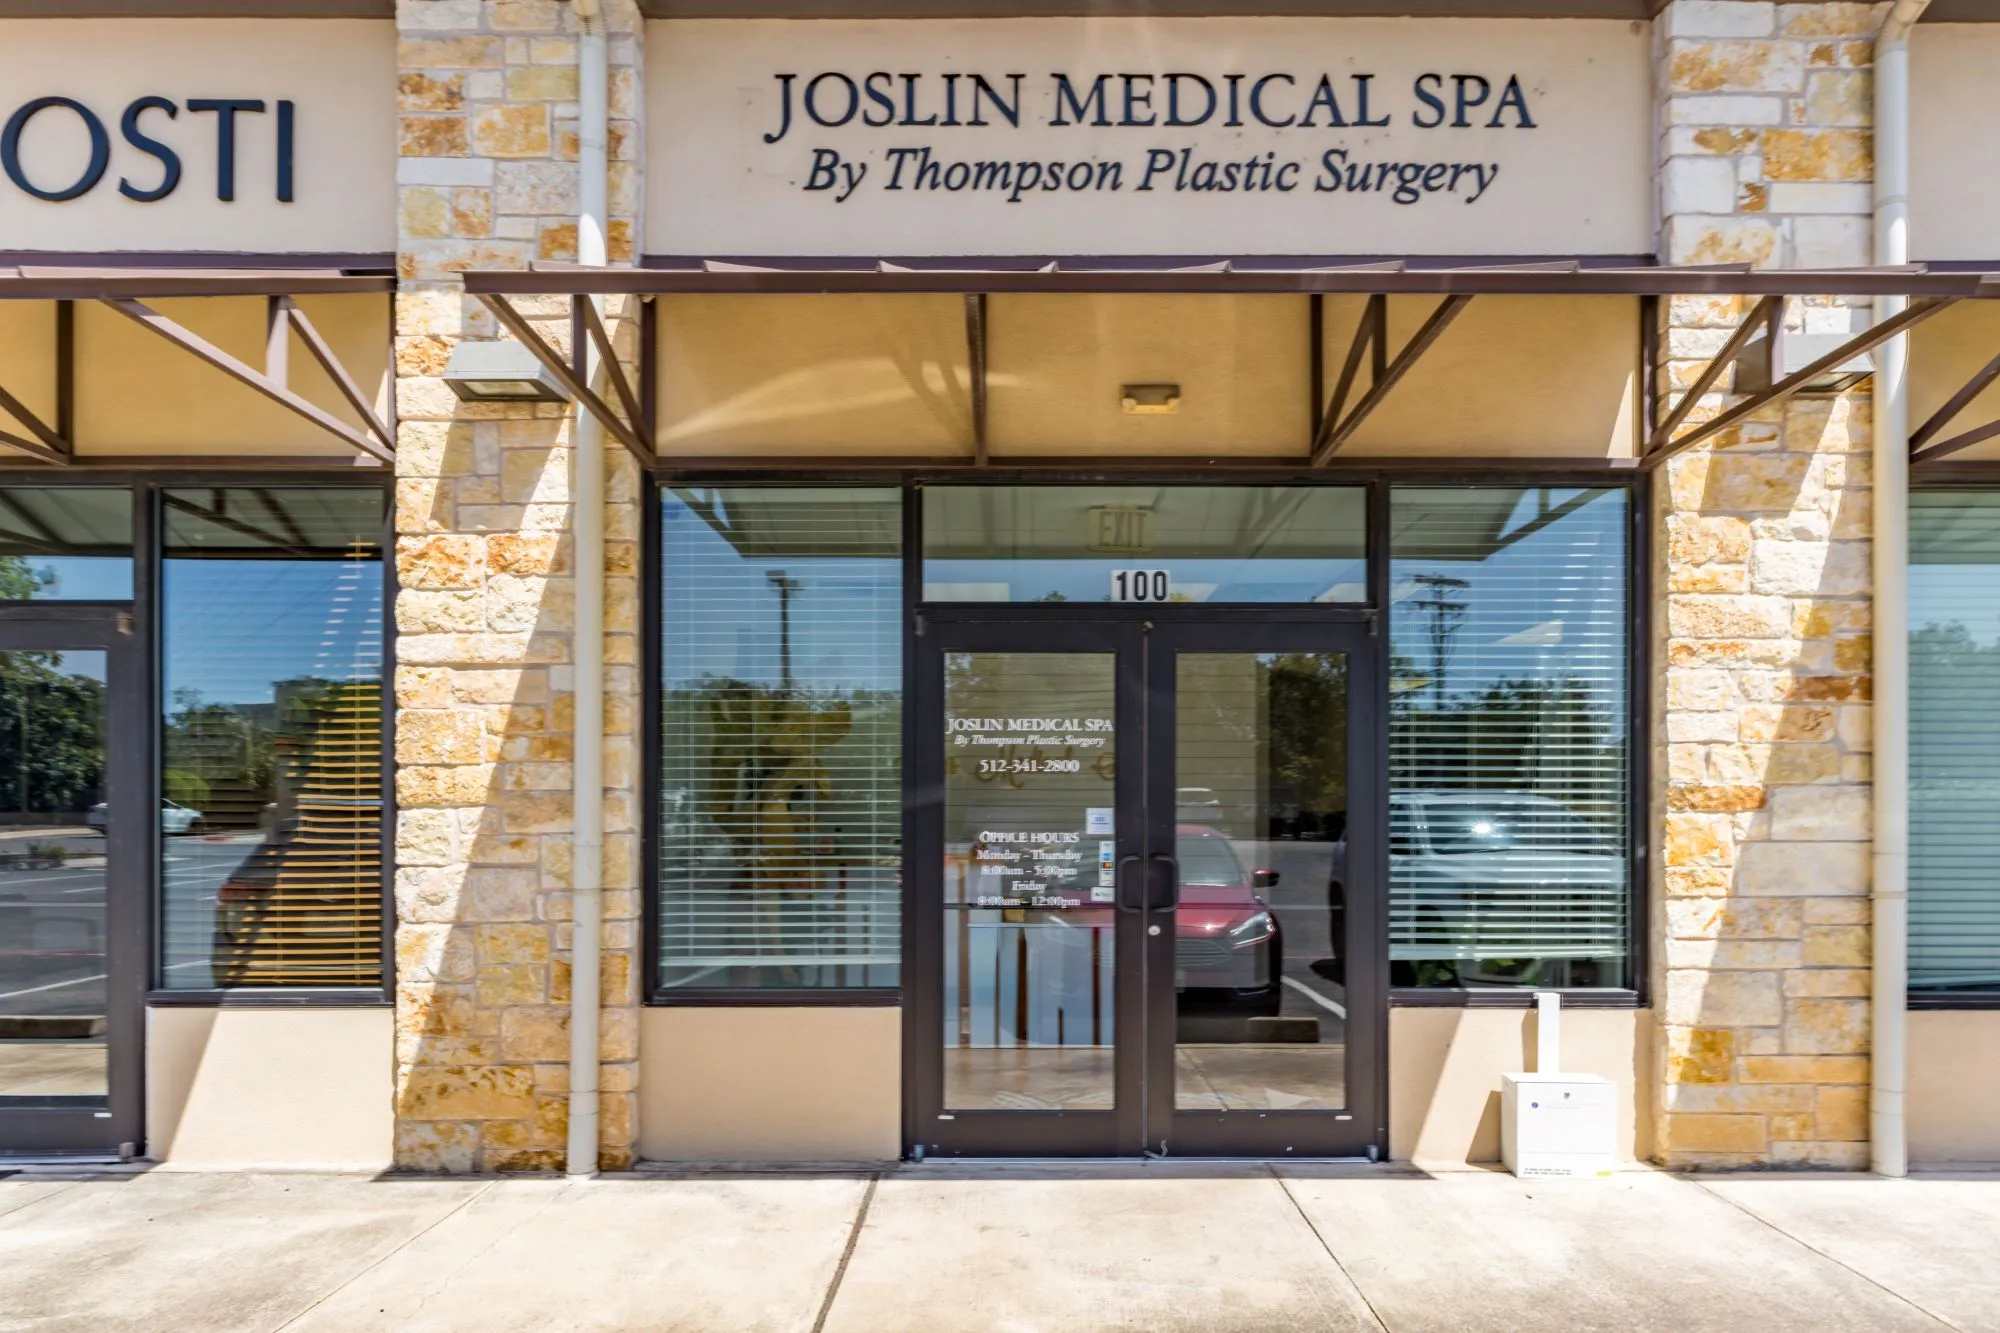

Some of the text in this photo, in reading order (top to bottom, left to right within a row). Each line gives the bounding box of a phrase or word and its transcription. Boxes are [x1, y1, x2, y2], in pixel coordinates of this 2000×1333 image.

[763, 72, 1538, 144] JOSLIN MEDICAL SPA
[0, 95, 295, 203] OSTI
[803, 146, 1498, 205] By Thompson Plastic Surgery
[1098, 511, 1148, 548] EXIT
[1115, 570, 1166, 601] 100
[945, 718, 1114, 734] JOSLIN MEDICAL SPA
[954, 734, 1106, 748] By Thompson Plastic Surgery
[979, 758, 1080, 773] 512-341-2800
[979, 831, 1080, 843] OFFICE HOURS
[976, 849, 1022, 862] Monday
[1032, 849, 1083, 862] Thursday
[1012, 880, 1048, 894] Friday
